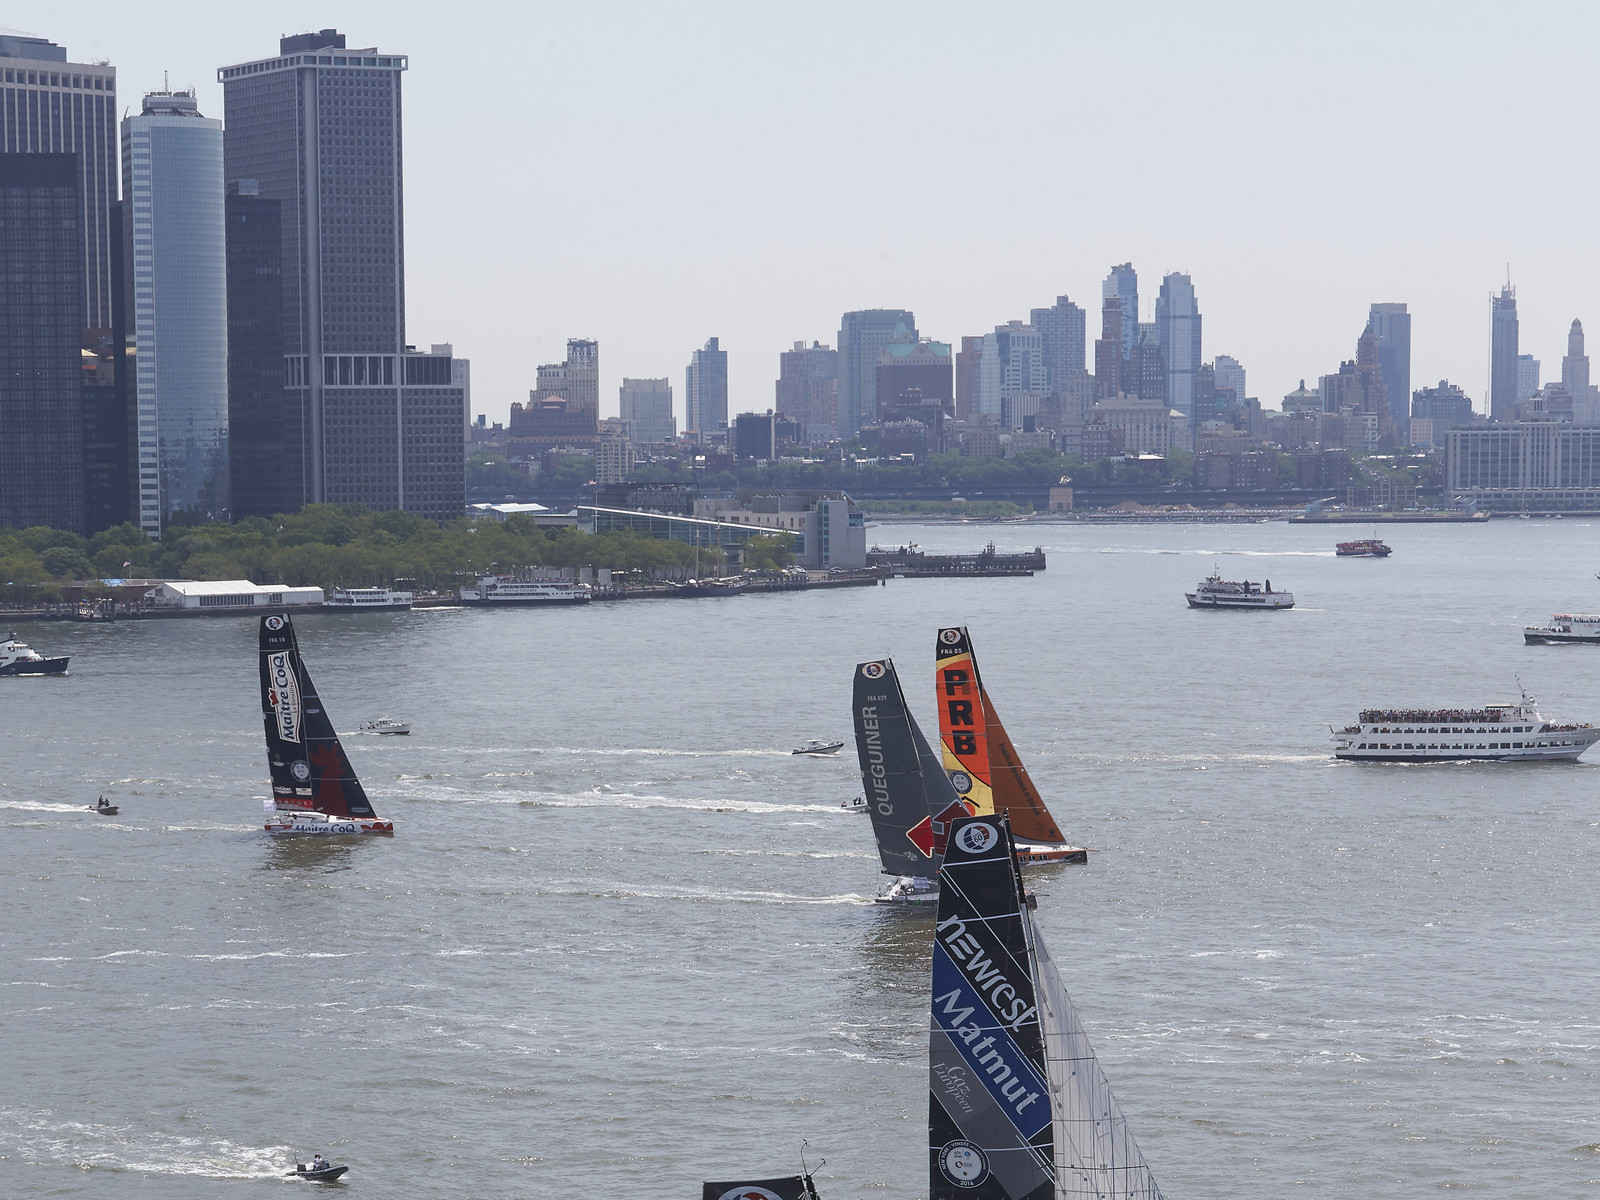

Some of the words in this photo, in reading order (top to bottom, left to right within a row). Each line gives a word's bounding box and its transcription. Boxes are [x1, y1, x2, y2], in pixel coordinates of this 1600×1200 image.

[273, 654, 288, 689] CoQ
[944, 668, 977, 756] PRB
[862, 705, 894, 817] QUEGUINER
[974, 834, 983, 843] 60
[934, 988, 1040, 1116] Matmut
[932, 1062, 973, 1114] Européen
[947, 1065, 972, 1100] Gaz
